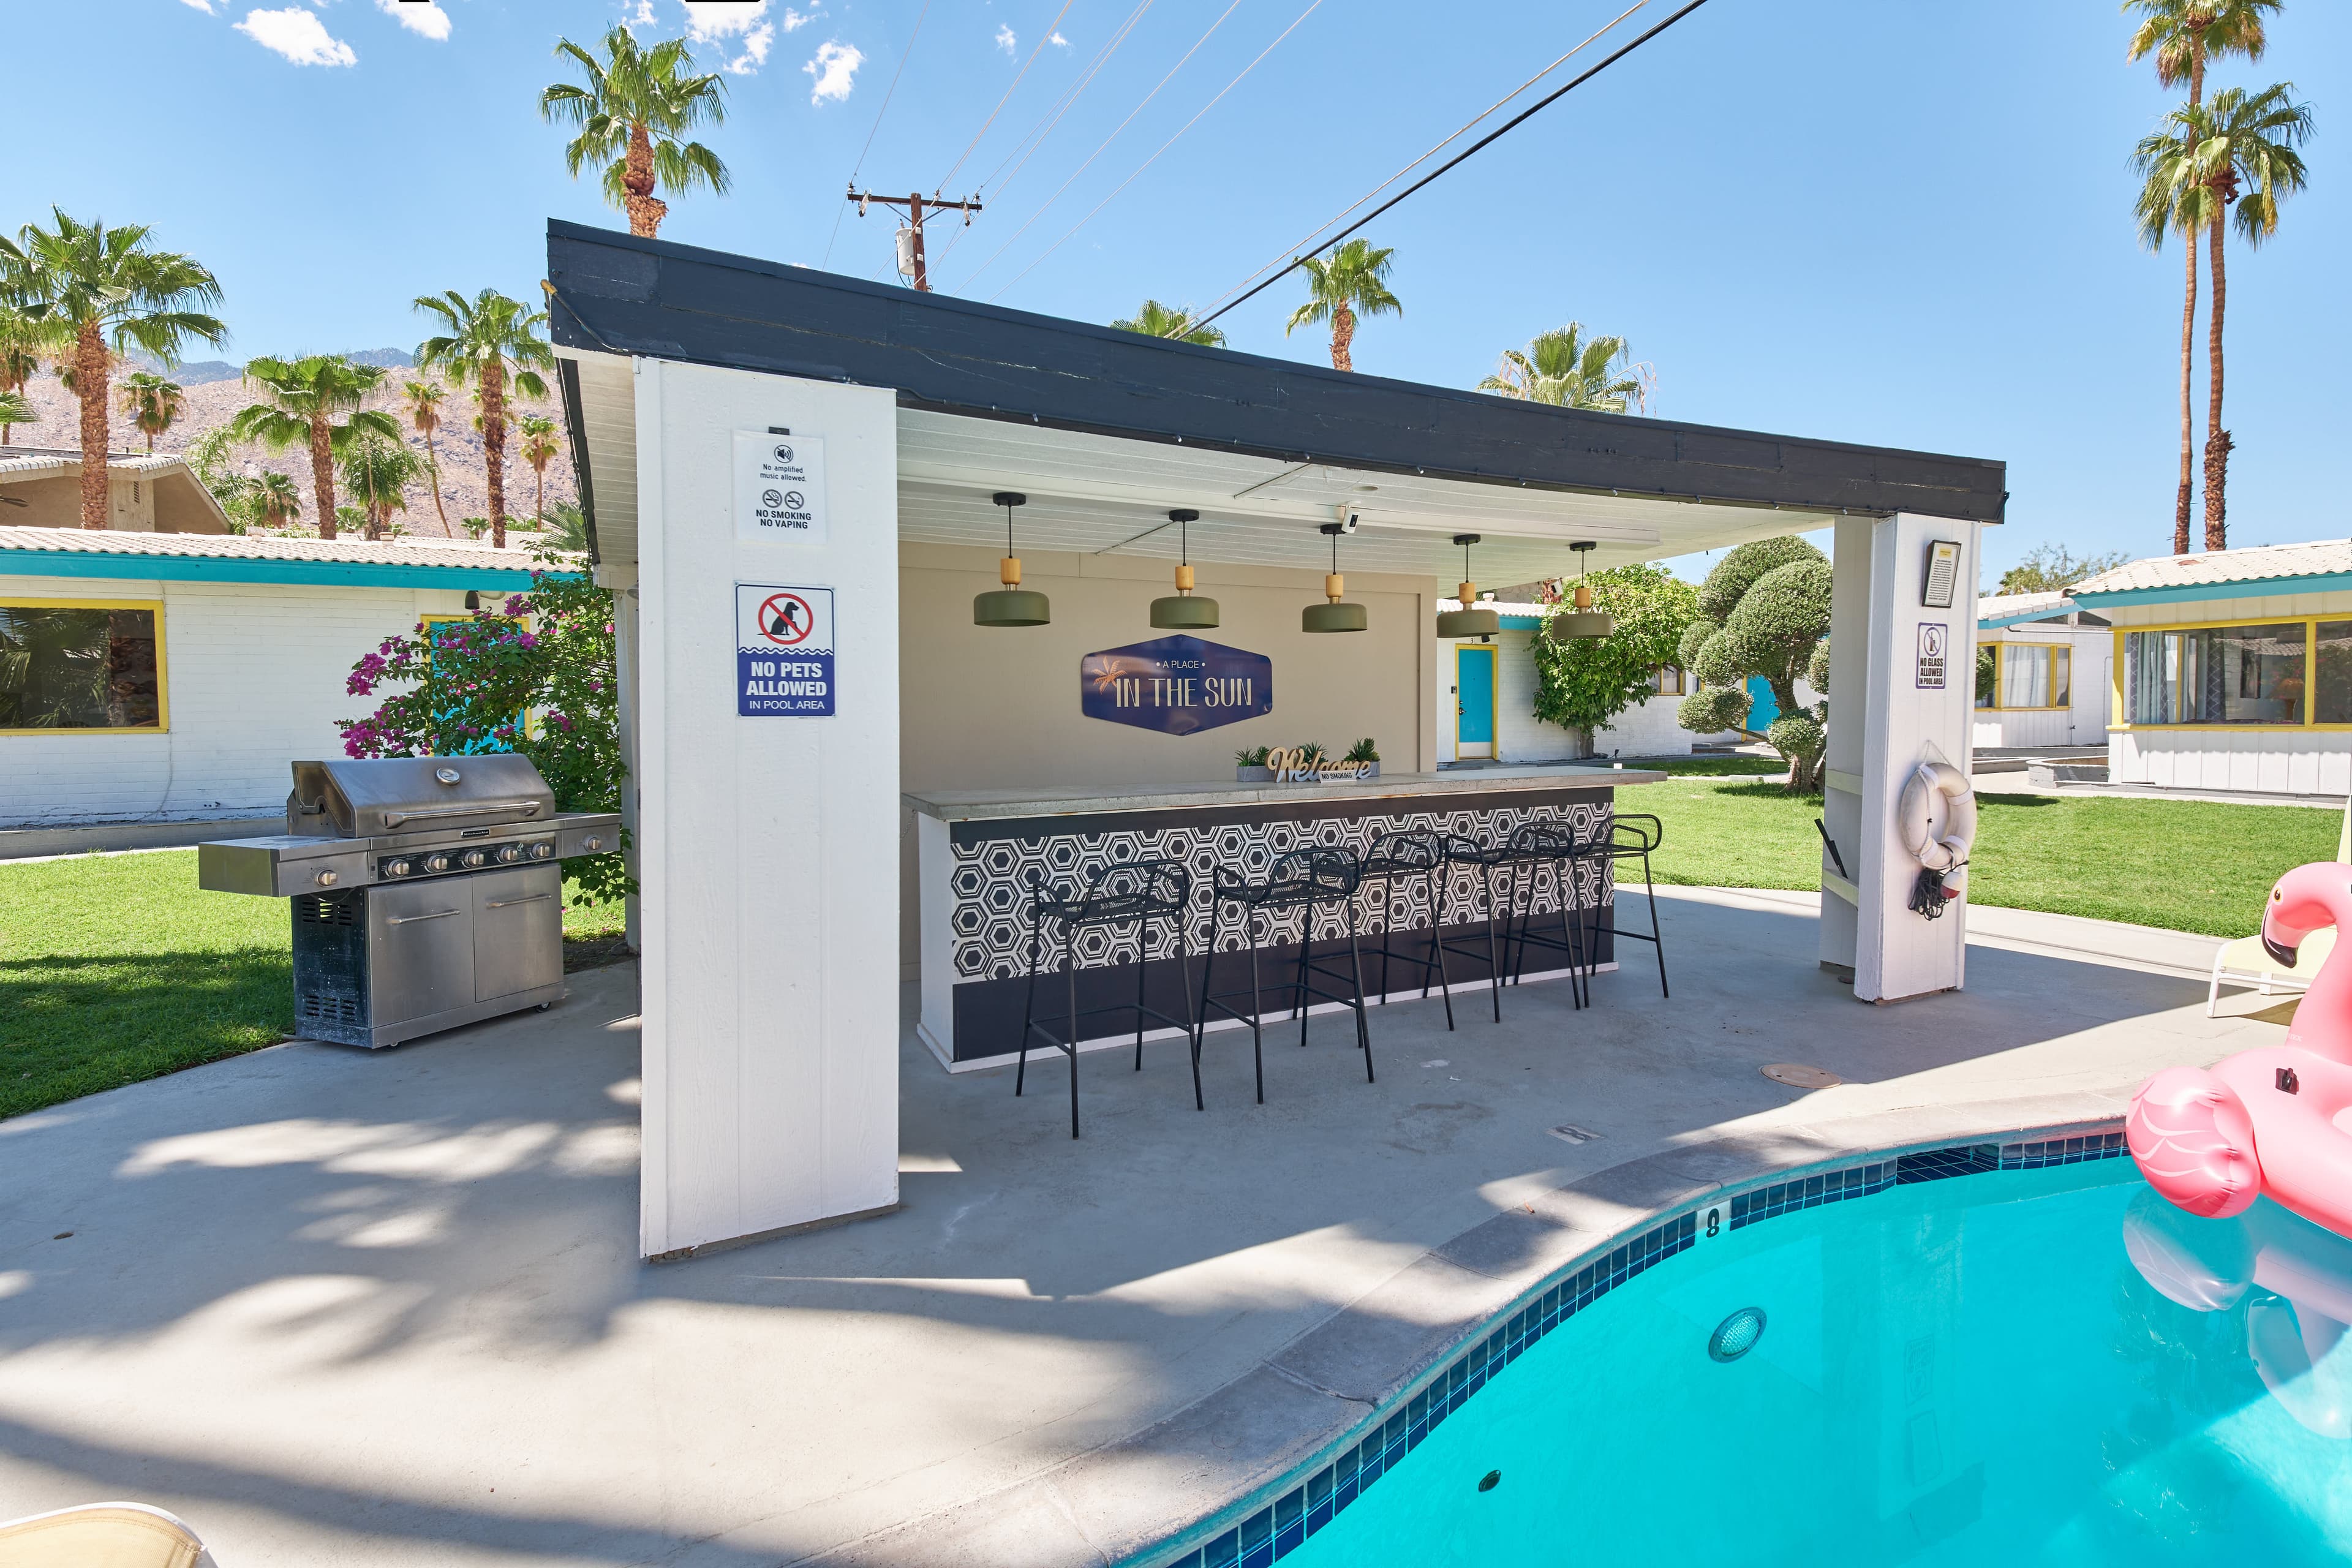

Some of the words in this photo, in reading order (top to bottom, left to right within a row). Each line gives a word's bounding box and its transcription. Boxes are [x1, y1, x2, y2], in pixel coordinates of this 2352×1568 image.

[771, 511, 812, 520] SMOKING
[775, 520, 808, 529] VAPING
[1920, 658, 1927, 666] NO
[1928, 658, 1943, 667] GLASS
[751, 662, 775, 677] NO
[780, 662, 823, 678] PETS
[1920, 668, 1942, 676] ALLOWED
[746, 680, 827, 696] ALLOWED
[1117, 678, 1140, 707] IN
[1148, 678, 1197, 707] THE
[1205, 677, 1251, 707] SUN
[750, 701, 760, 709] IN
[764, 701, 794, 709] POOL
